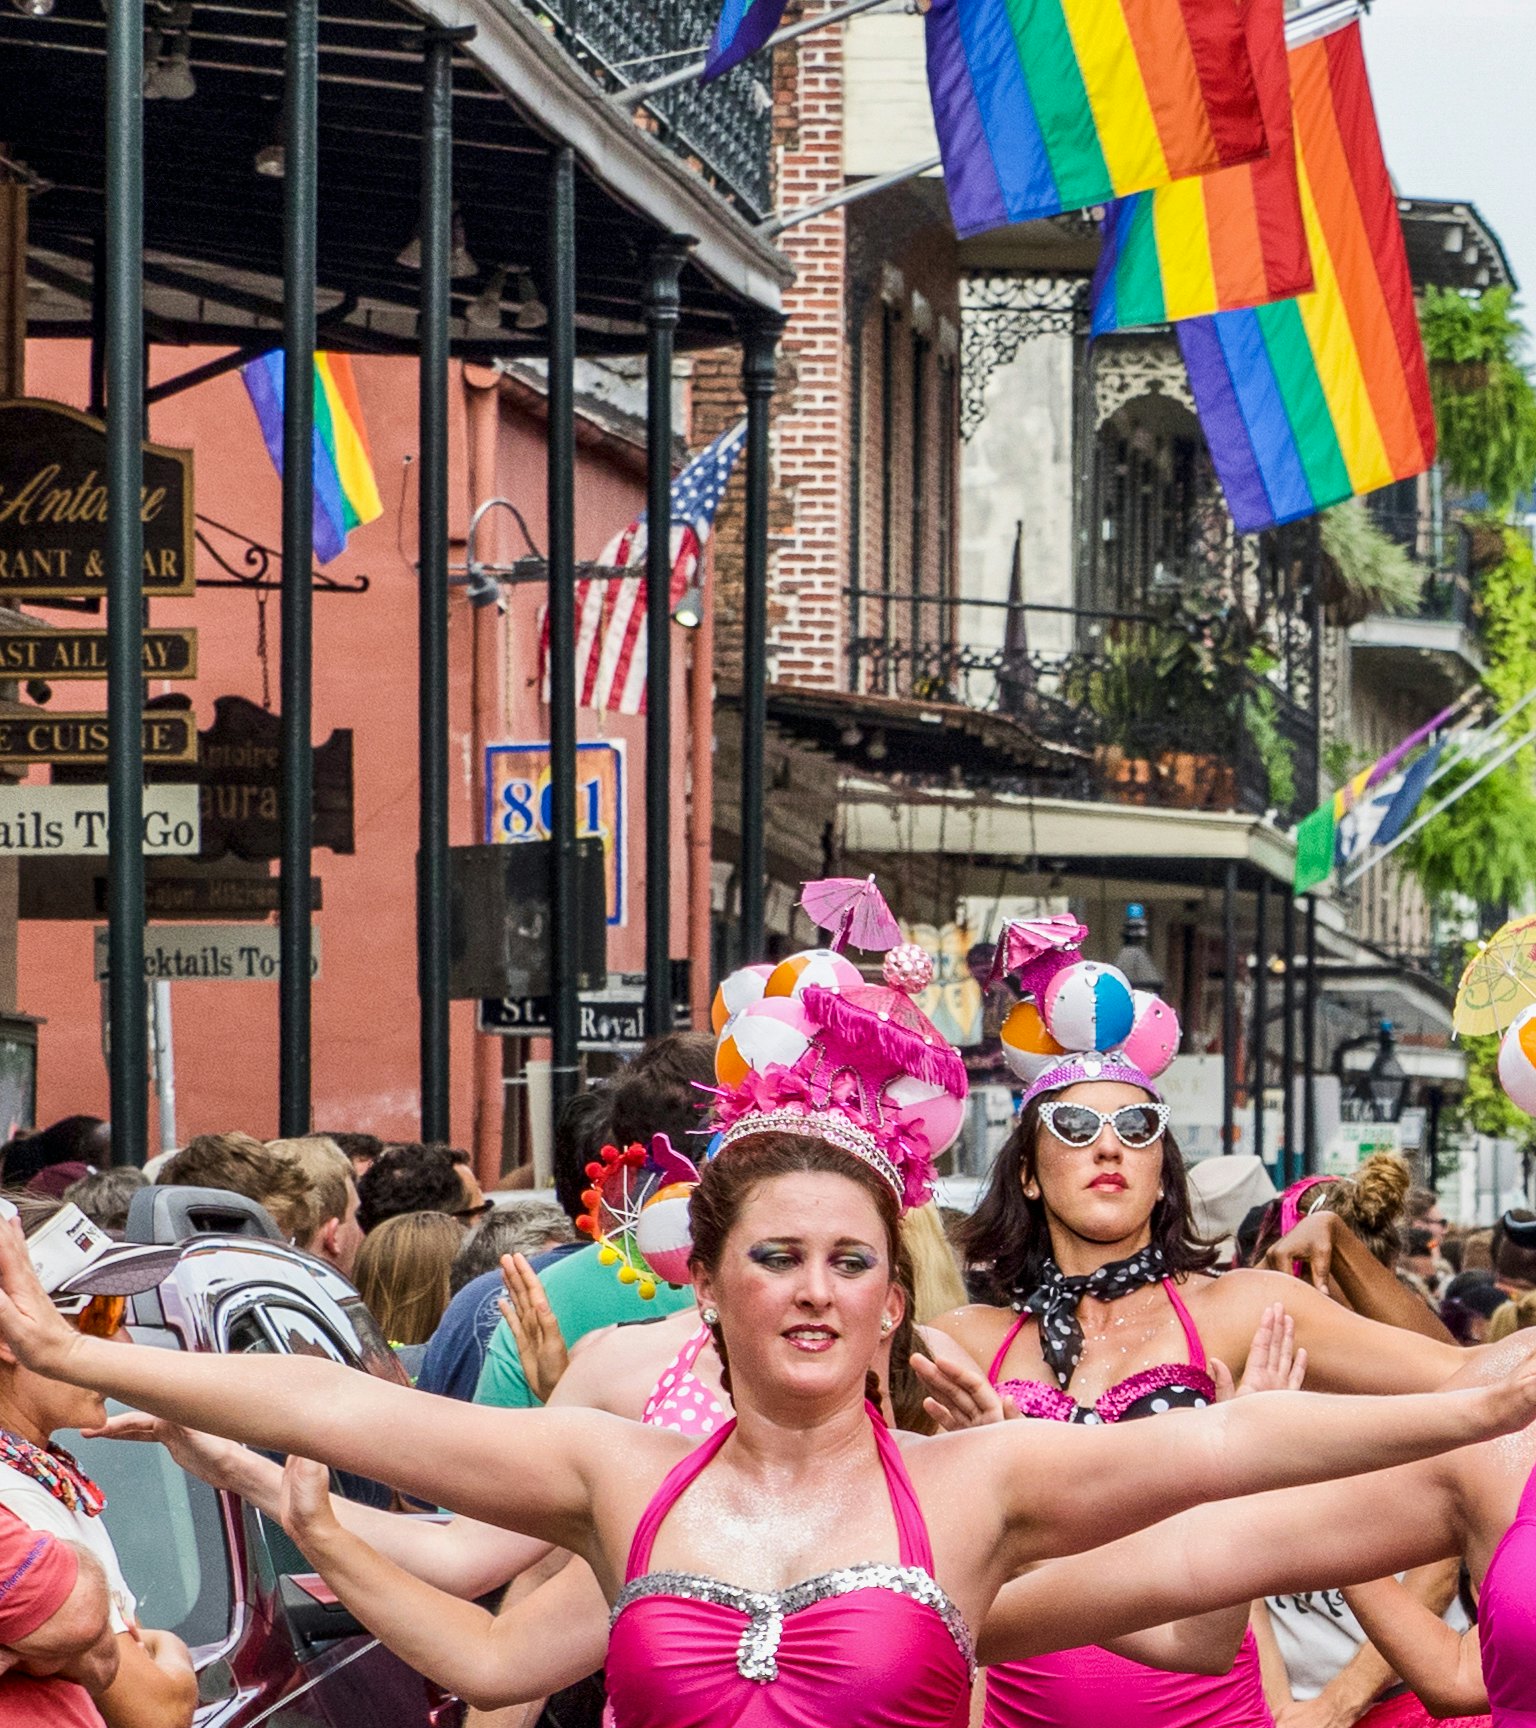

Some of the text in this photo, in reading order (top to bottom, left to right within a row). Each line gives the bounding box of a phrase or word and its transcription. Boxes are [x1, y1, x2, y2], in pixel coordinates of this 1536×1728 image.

[84, 549, 104, 577] &
[143, 549, 177, 577] AR
[143, 641, 172, 667] AY
[28, 724, 170, 751] CUISE
[143, 811, 194, 848] Go
[501, 997, 546, 1022] St.
